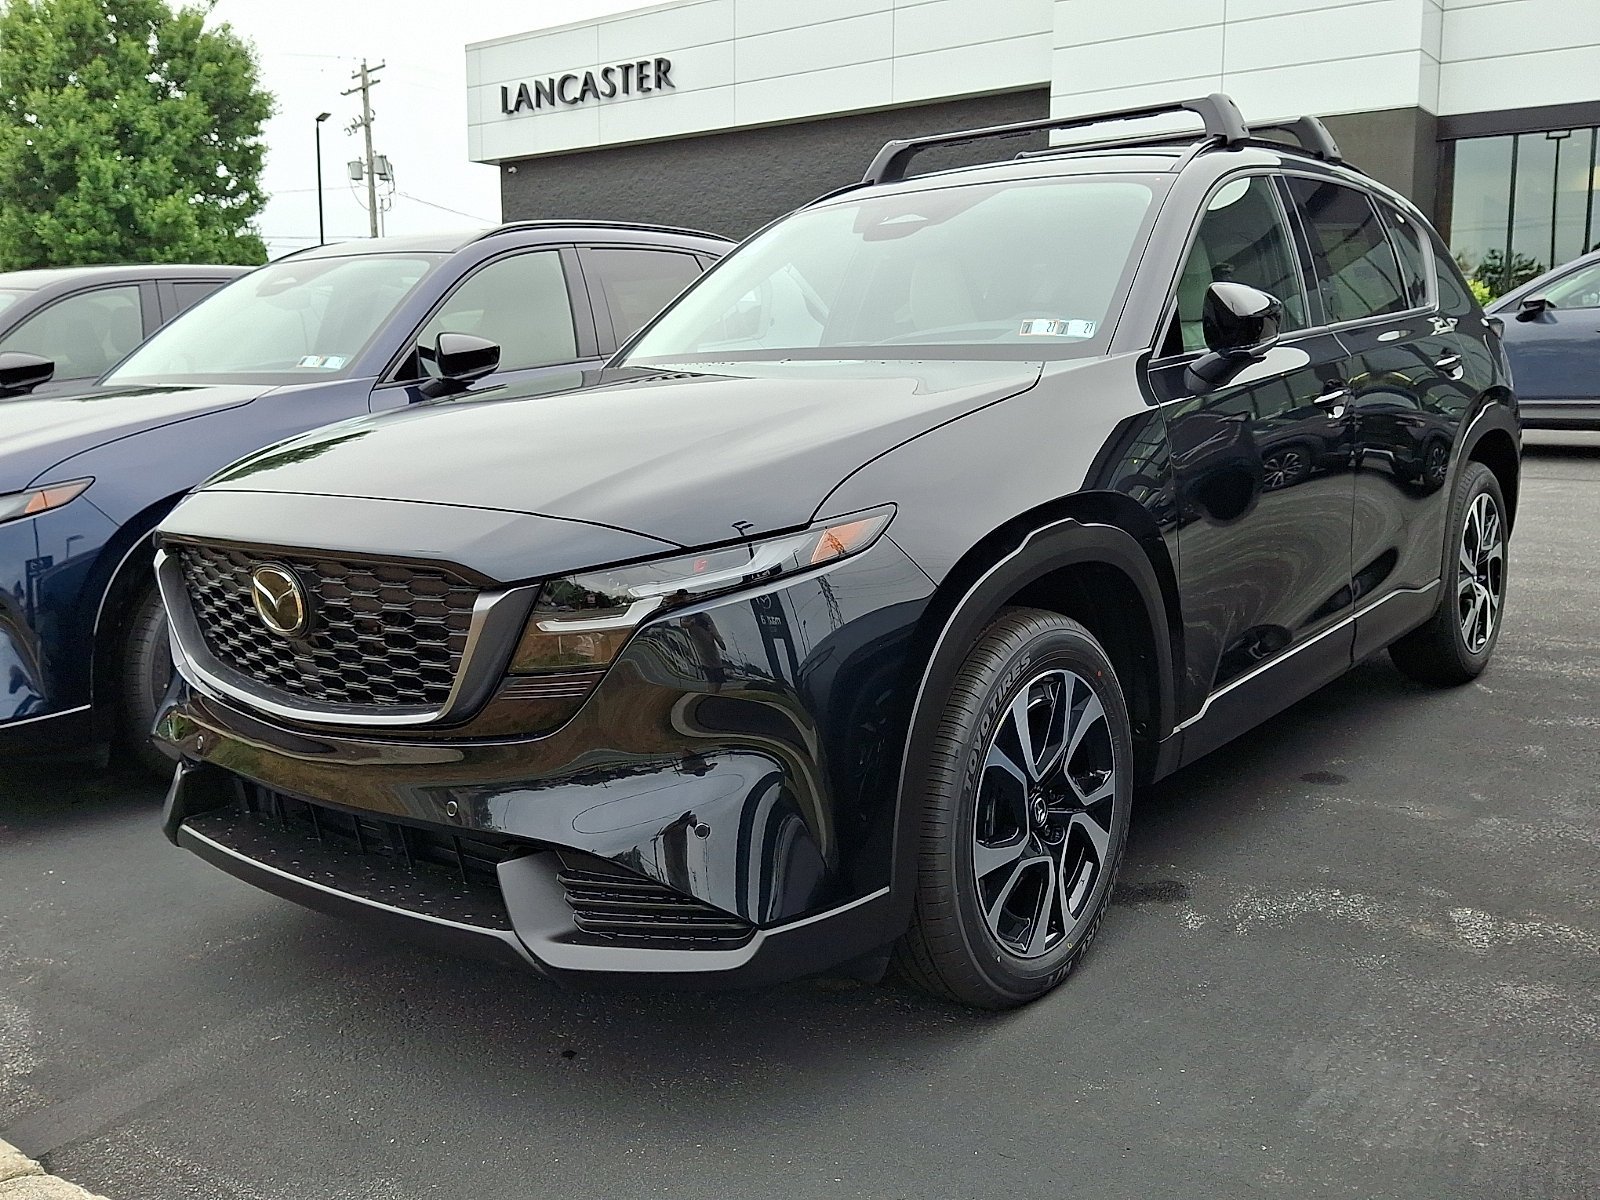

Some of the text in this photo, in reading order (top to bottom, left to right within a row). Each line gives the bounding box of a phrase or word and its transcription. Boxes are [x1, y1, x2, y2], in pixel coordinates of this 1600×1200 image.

[501, 57, 676, 114] LANCASTER
[964, 651, 1032, 792] TOYO TIRES
